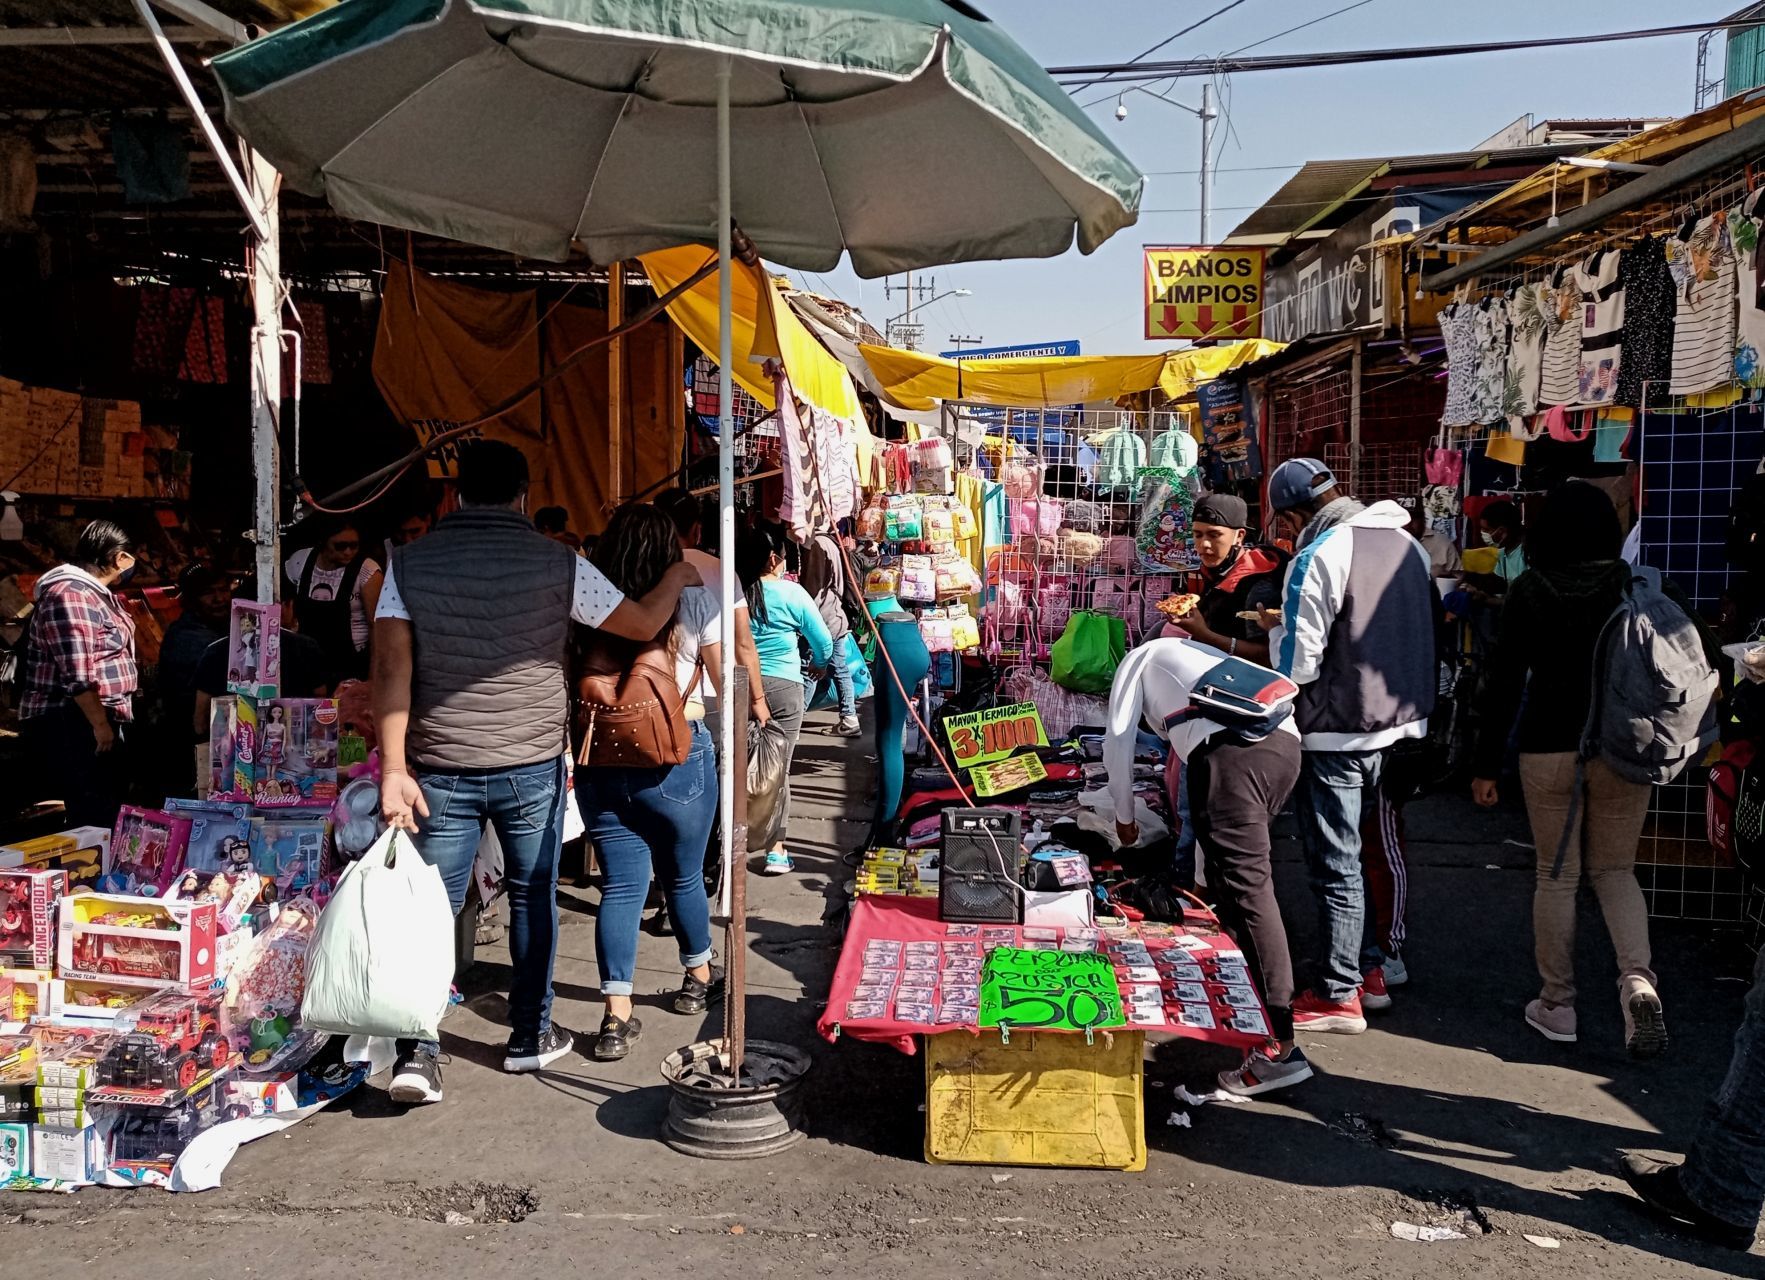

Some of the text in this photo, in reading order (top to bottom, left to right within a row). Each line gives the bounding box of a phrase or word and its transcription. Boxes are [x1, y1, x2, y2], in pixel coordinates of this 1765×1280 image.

[1158, 255, 1252, 277] BAÑOS
[1152, 284, 1258, 304] LIMPIOS
[1329, 255, 1363, 320] WC
[1058, 346, 1066, 354] Y
[981, 705, 1018, 721] TERMICO
[996, 986, 1109, 1029] 50
[90, 1093, 165, 1106] RACING
